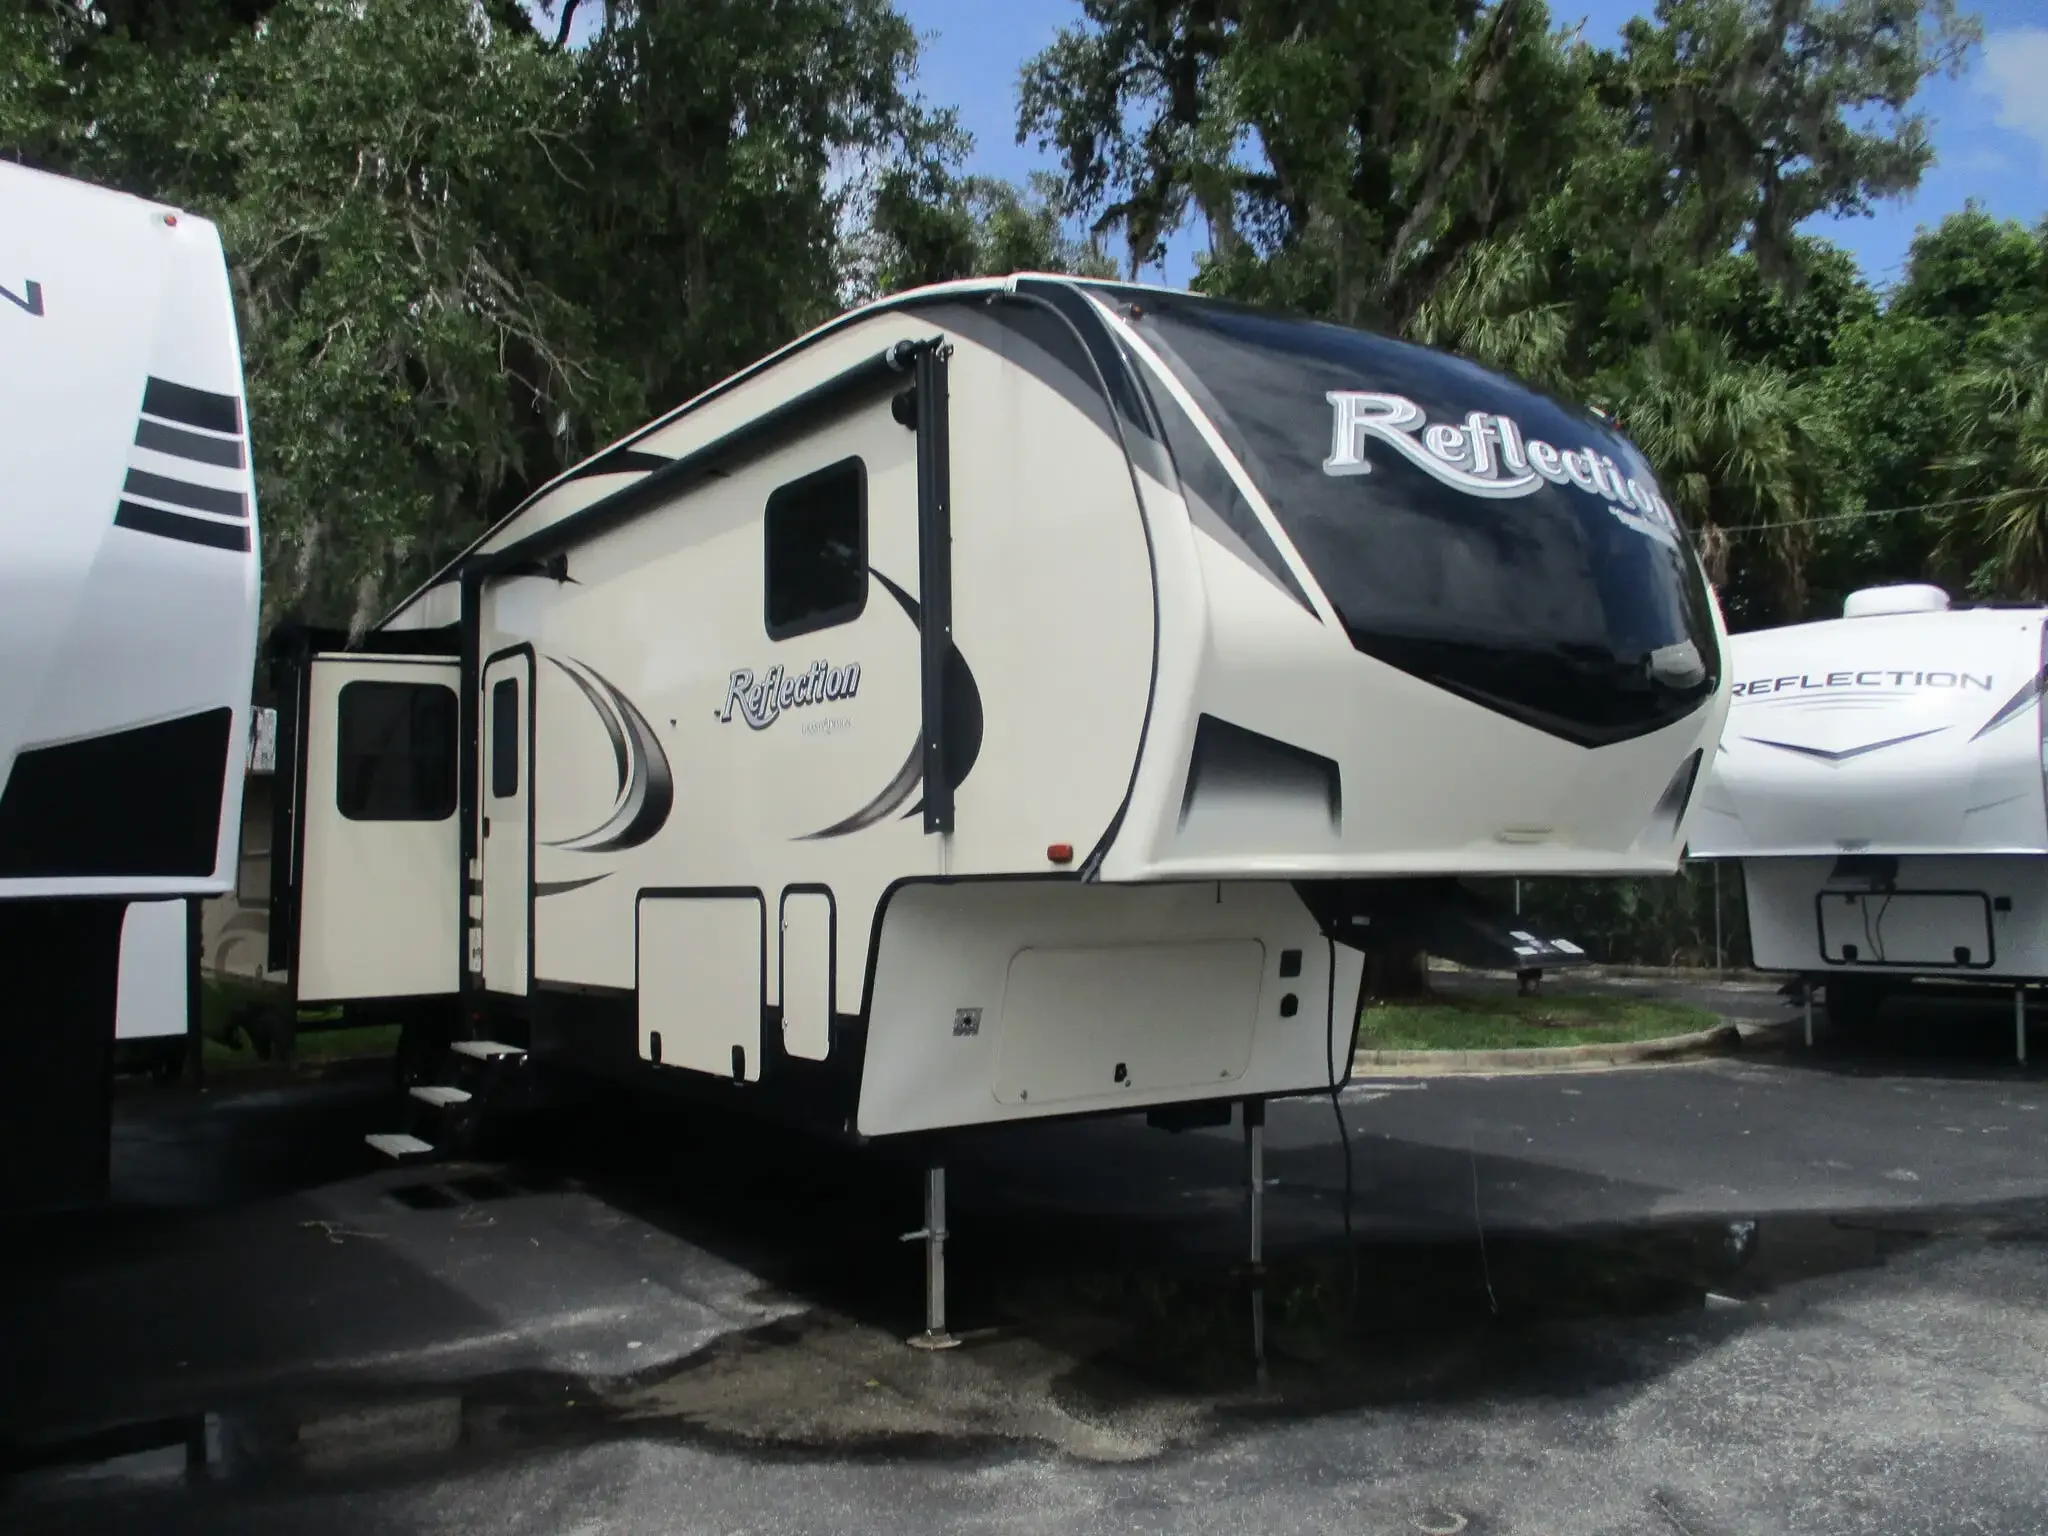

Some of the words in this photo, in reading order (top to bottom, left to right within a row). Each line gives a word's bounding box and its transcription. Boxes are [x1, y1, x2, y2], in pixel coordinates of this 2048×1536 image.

[1322, 390, 1682, 541] Reflection
[721, 659, 861, 731] Reflection
[1732, 670, 1993, 697] REFLECTION
